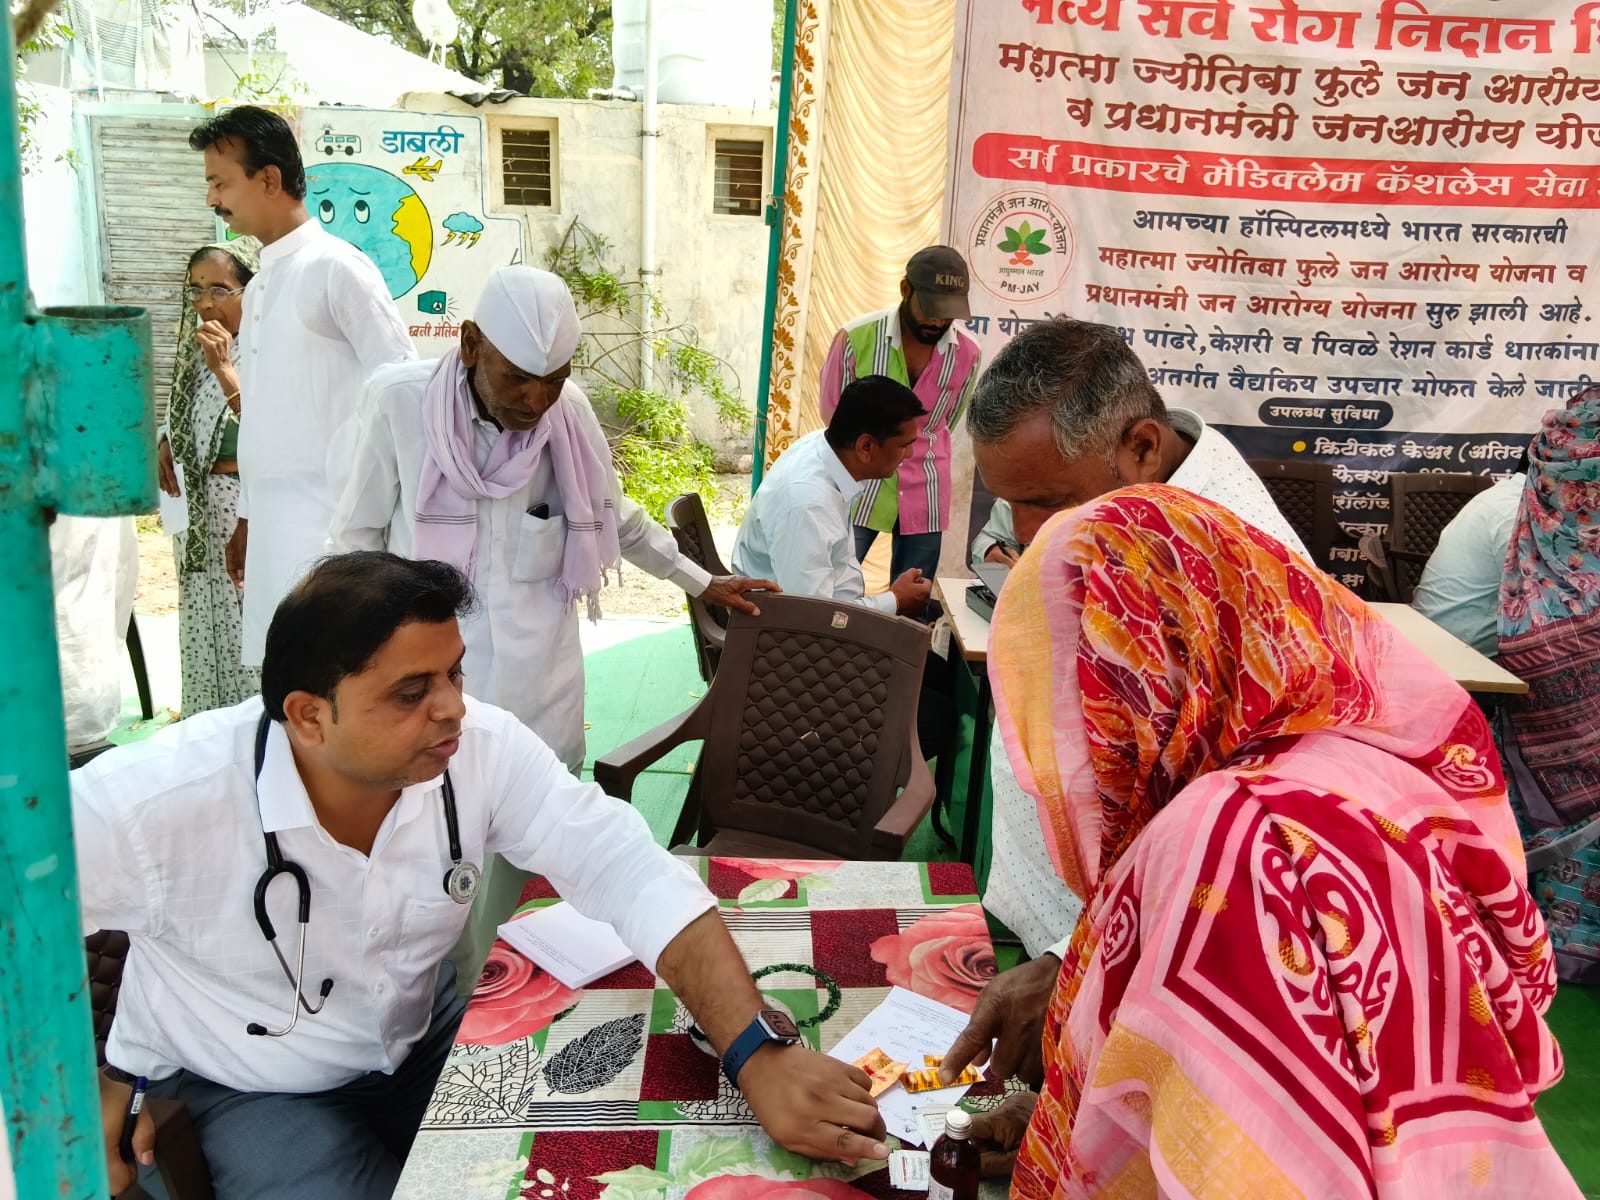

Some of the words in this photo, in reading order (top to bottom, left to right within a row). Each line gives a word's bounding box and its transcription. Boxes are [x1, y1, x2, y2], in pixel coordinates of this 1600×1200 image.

[1249, 0, 1362, 48] रोग
[1375, 0, 1556, 58] निदान
[1133, 53, 1302, 96] ज्योतिबा
[1313, 60, 1383, 107] फुले
[1397, 70, 1471, 101] जन
[379, 125, 465, 158] डाबली
[1066, 98, 1094, 127] व
[1103, 101, 1299, 141] प्रधानमंत्री
[1312, 109, 1525, 149] जनआरोग्य
[1070, 154, 1191, 184] प्रकारचे
[1203, 158, 1365, 193] मेडिक्लेम
[1377, 165, 1513, 196] कॅशलेस
[1525, 168, 1589, 198] सेवा
[1006, 197, 1026, 209] जन
[1133, 209, 1229, 235] आमच्या
[1239, 208, 1391, 241] हॉस्पिटलमध्ये
[1402, 221, 1462, 242] भारत
[1472, 218, 1568, 244] सरकारची
[1098, 247, 1176, 272] महात्मा
[1186, 247, 1286, 278] ज्योतिबा
[1296, 252, 1340, 286] फुले
[1350, 261, 1389, 281] जन
[1398, 254, 1480, 283] आरोग्य
[1489, 256, 1557, 284] योजना
[1567, 264, 1587, 283] व
[1000, 280, 1040, 294] PM-JAY
[1085, 283, 1189, 312] प्रधानमंत्री
[1198, 293, 1236, 314] जन
[1247, 290, 1332, 318] आरोग्य
[1341, 292, 1417, 320] योजना
[1469, 296, 1528, 325] झाली
[1283, 335, 1302, 354] व
[1312, 331, 1379, 357] पिवळे
[1389, 331, 1436, 360] रेशन
[1445, 333, 1493, 360] कार्ड
[1505, 333, 1600, 361] धारकांना
[1327, 376, 1402, 396] उपचार
[1412, 371, 1477, 398] मोफत
[1487, 372, 1526, 399] केले
[1535, 374, 1600, 400] जाती
[1270, 405, 1326, 420] उपलब्ध
[1330, 406, 1380, 425] सुविधा
